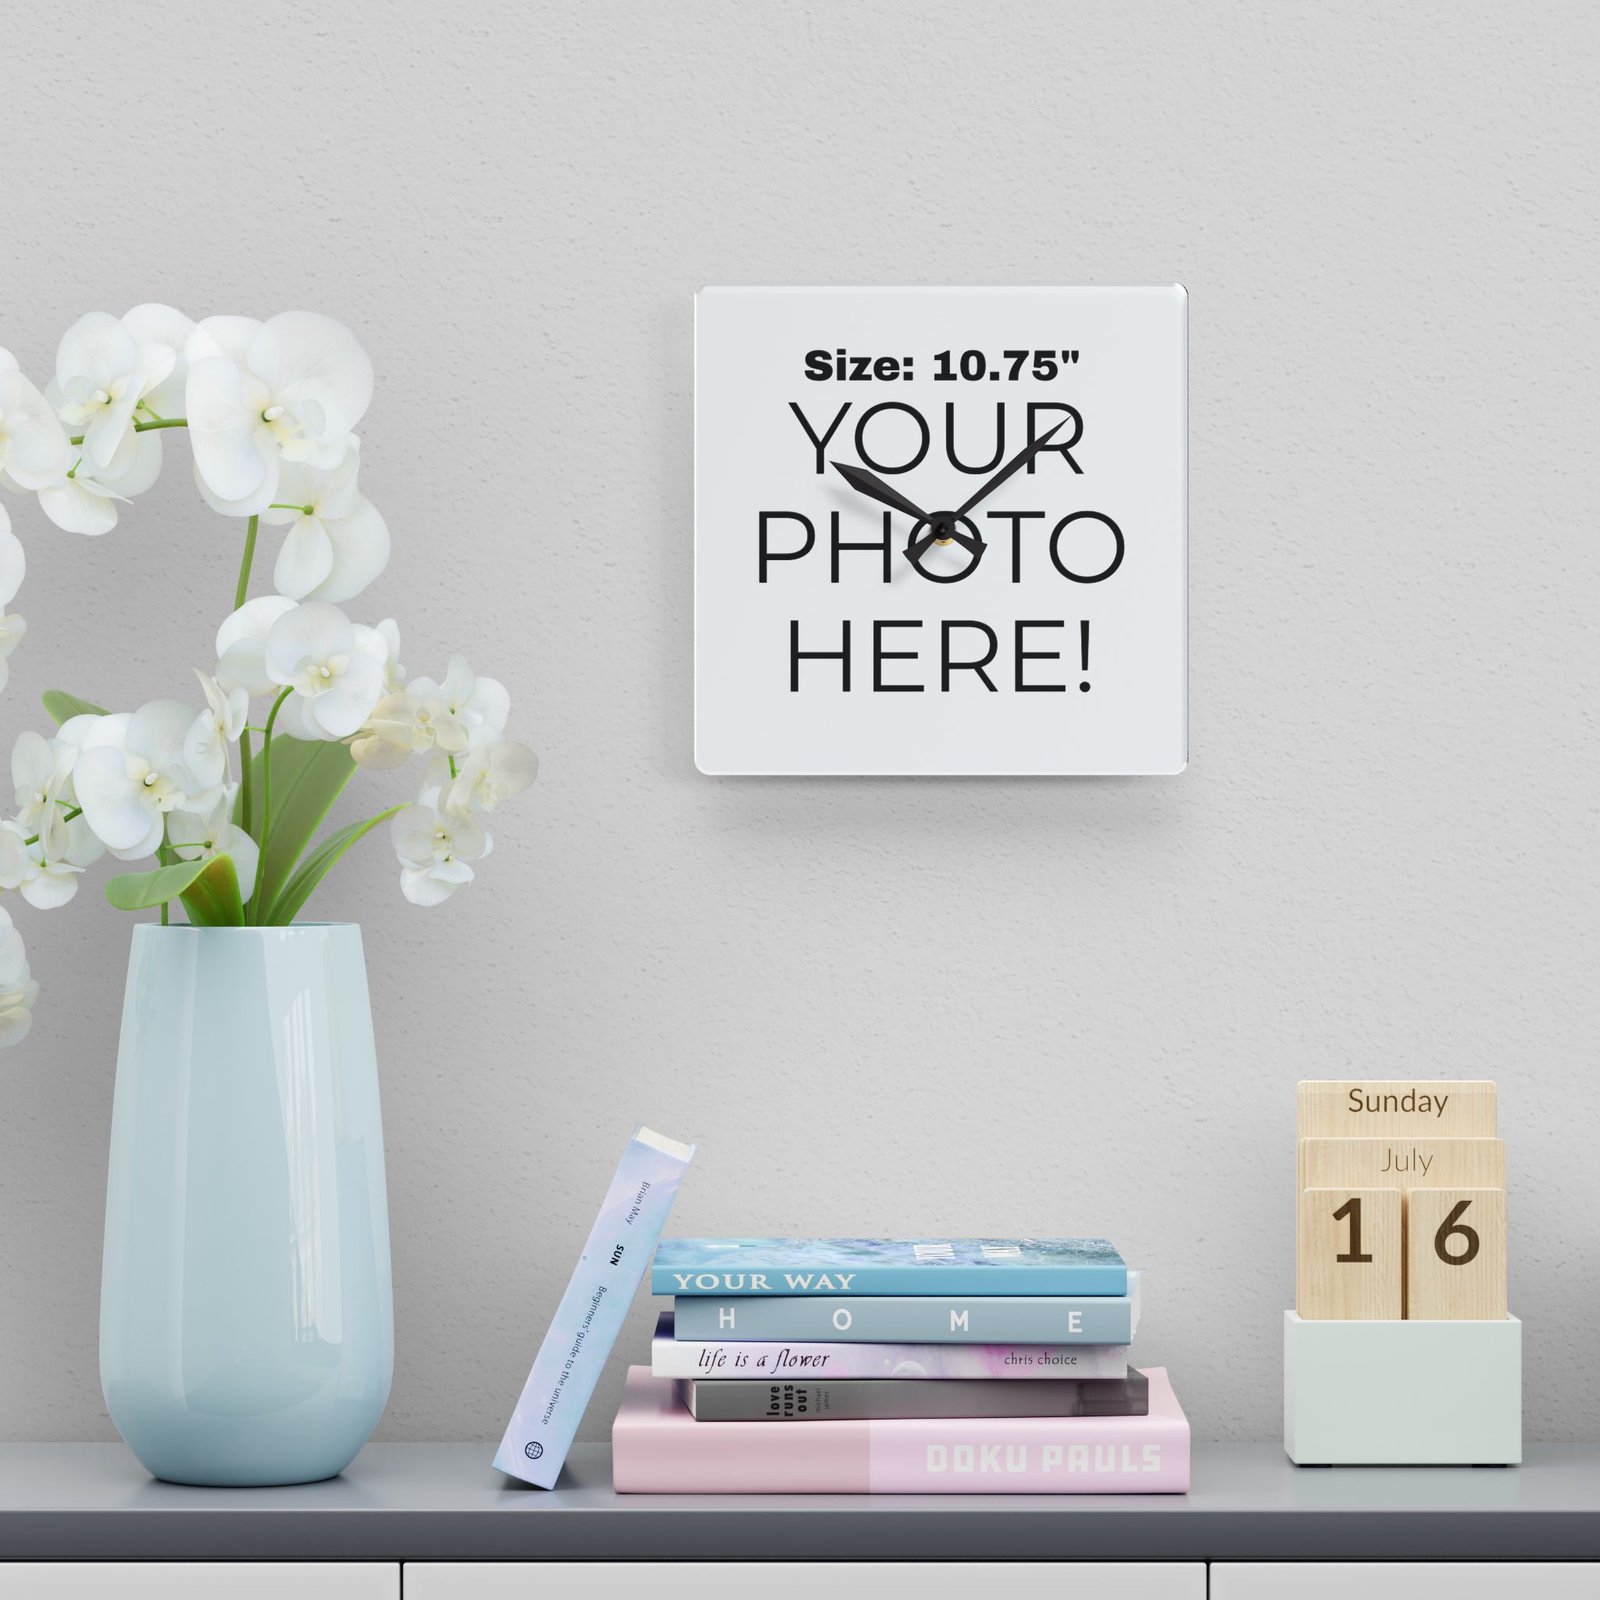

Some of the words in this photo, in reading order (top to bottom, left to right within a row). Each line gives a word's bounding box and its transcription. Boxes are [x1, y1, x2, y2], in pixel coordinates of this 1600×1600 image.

[804, 349, 914, 382] Size:
[933, 350, 1080, 382] 10.75"
[789, 401, 1084, 475] YOUR
[758, 510, 1125, 584] PHOTO
[790, 620, 1092, 693] HERE!
[1348, 1088, 1449, 1118] Sunday
[1381, 1147, 1434, 1177] July
[635, 1181, 651, 1205] Brian
[625, 1206, 641, 1226] May
[609, 1244, 625, 1266] SUN
[672, 1273, 773, 1291] YOUR
[783, 1273, 857, 1291] WAY
[569, 1331, 585, 1358] guide
[564, 1359, 574, 1370] to
[698, 1348, 727, 1374] life
[735, 1351, 749, 1367] is
[756, 1355, 768, 1367] a
[769, 1348, 830, 1374] flower
[1004, 1352, 1034, 1366] chris
[1037, 1352, 1077, 1366] choice
[558, 1370, 570, 1387] the
[541, 1387, 562, 1426] universe
[766, 1386, 780, 1416] love
[784, 1385, 794, 1417] runs
[795, 1389, 807, 1412] out
[926, 1444, 1028, 1473] DOKU
[1042, 1444, 1161, 1473] PAULS
